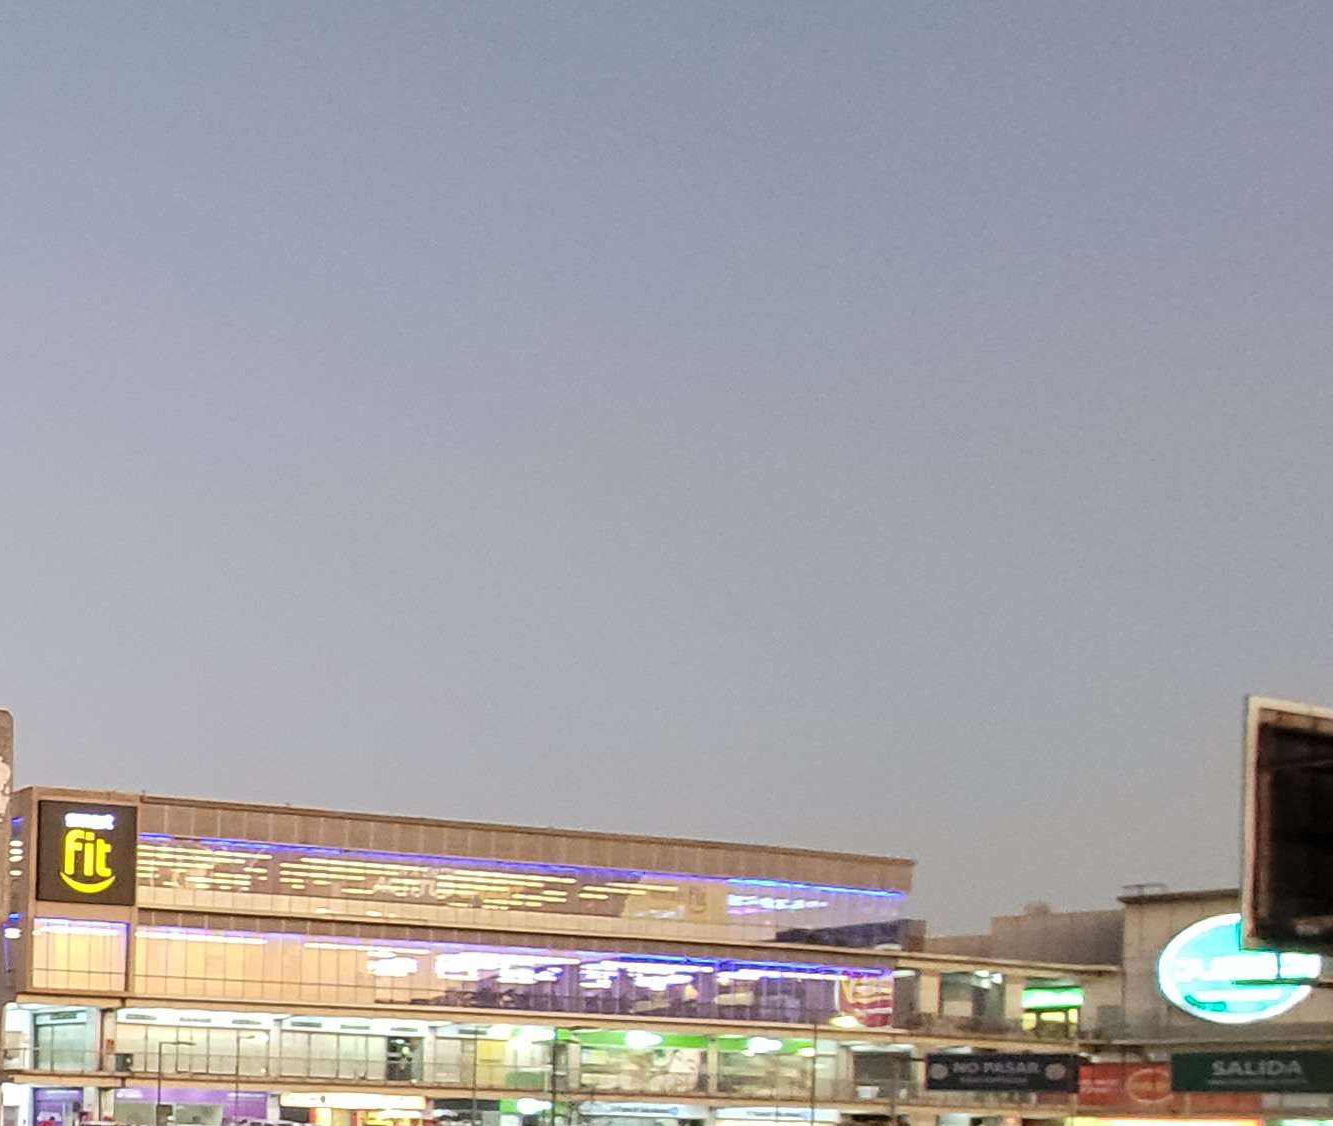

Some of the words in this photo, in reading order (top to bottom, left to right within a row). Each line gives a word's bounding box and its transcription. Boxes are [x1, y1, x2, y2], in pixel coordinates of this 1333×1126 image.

[64, 829, 112, 877] fit
[953, 1062, 980, 1074] NO
[1211, 1060, 1302, 1076] SALIDA
